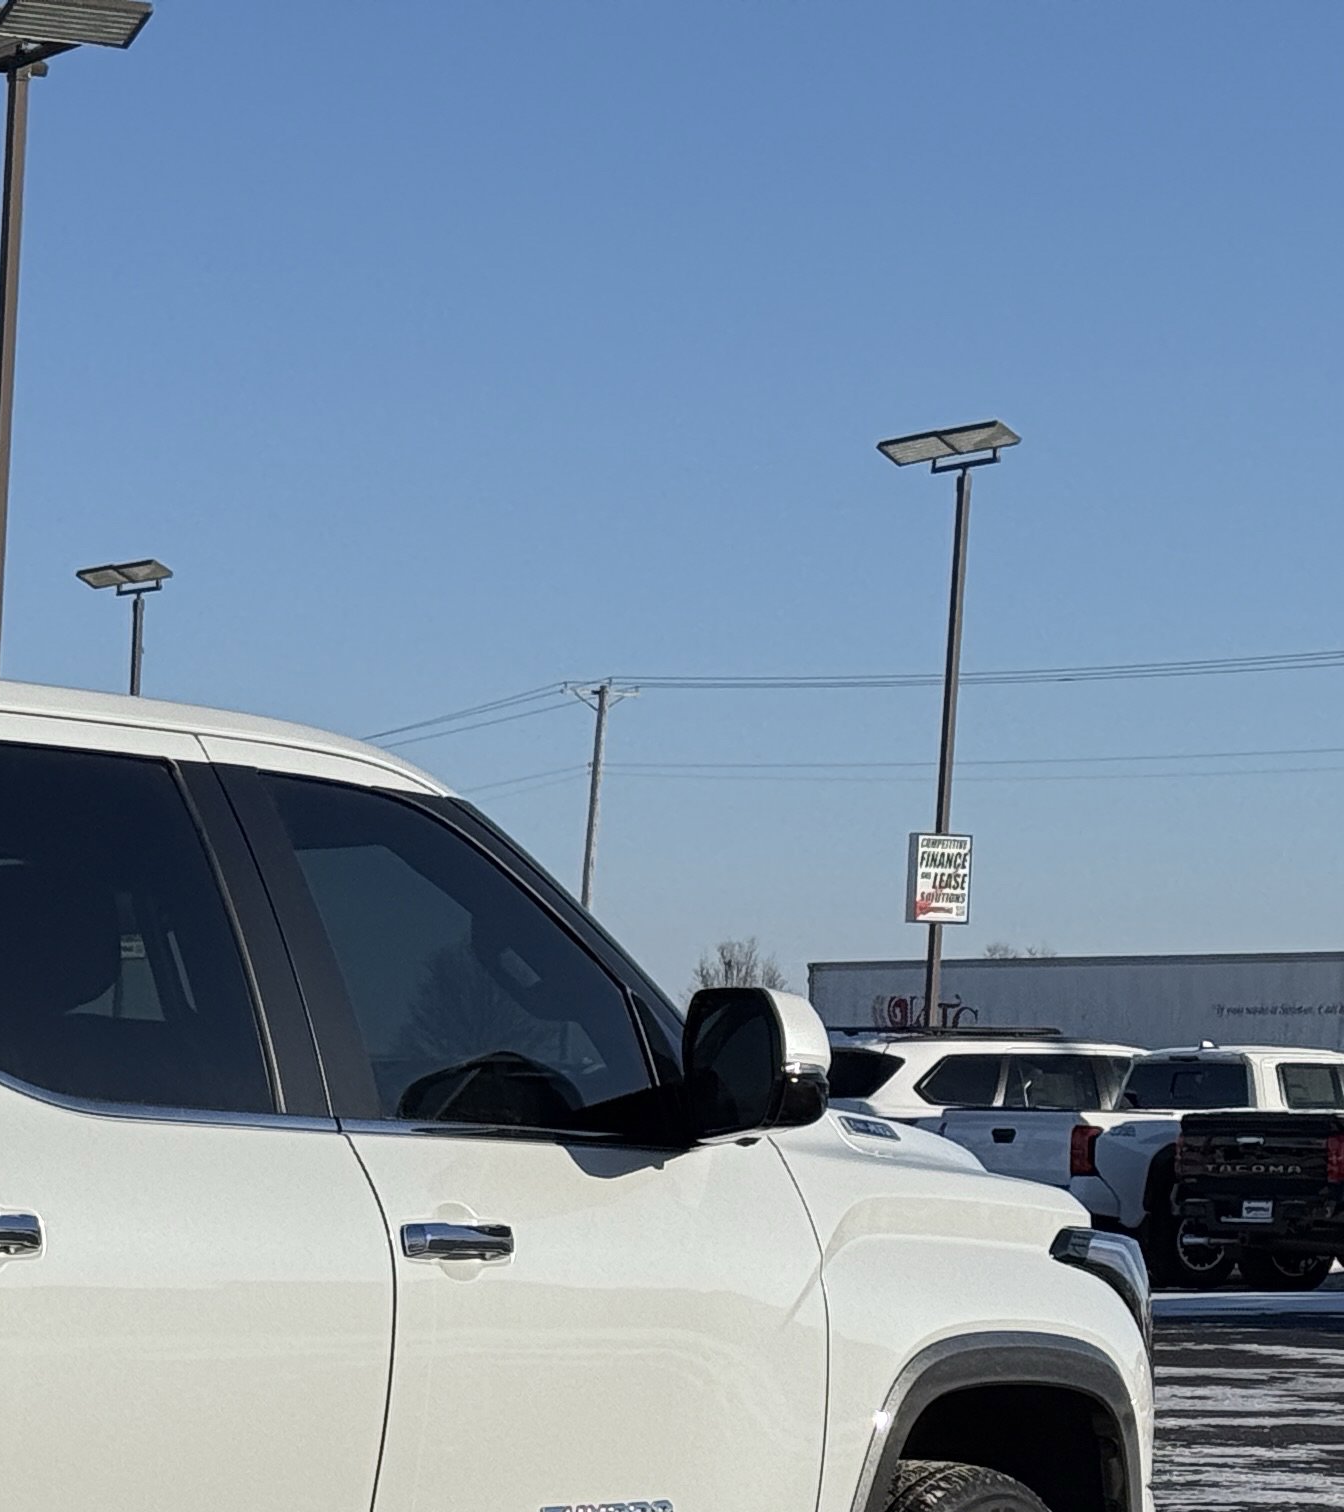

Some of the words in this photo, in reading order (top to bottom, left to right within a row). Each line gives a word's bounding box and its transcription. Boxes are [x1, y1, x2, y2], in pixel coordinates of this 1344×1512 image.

[920, 850, 969, 870] FINANCE
[932, 872, 968, 891] LEASE
[919, 891, 967, 904] SOLUTIONS
[1205, 1164, 1302, 1173] TACOMA
